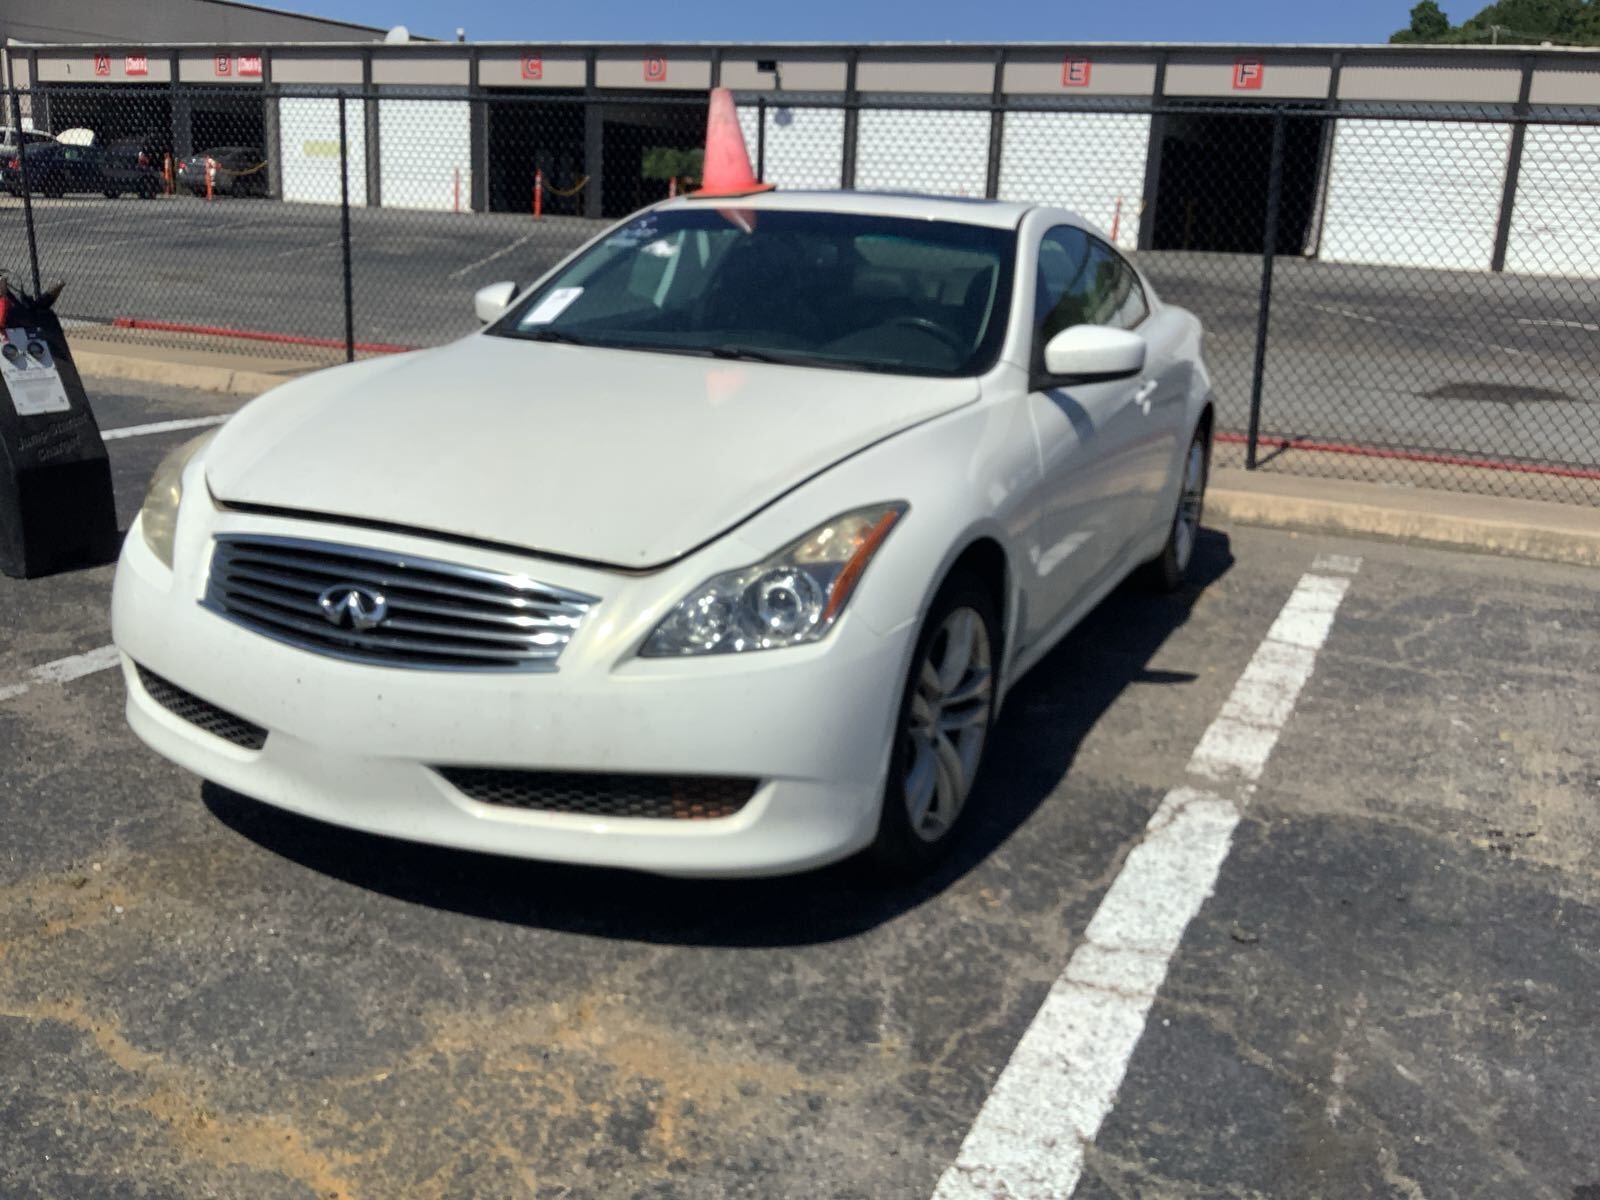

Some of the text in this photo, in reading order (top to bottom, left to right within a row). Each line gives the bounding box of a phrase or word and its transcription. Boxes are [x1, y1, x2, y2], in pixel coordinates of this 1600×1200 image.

[95, 56, 110, 74] A
[216, 55, 229, 73] B
[524, 56, 541, 78] C
[646, 55, 665, 79] D
[1066, 58, 1087, 85] E
[1236, 61, 1258, 87] F
